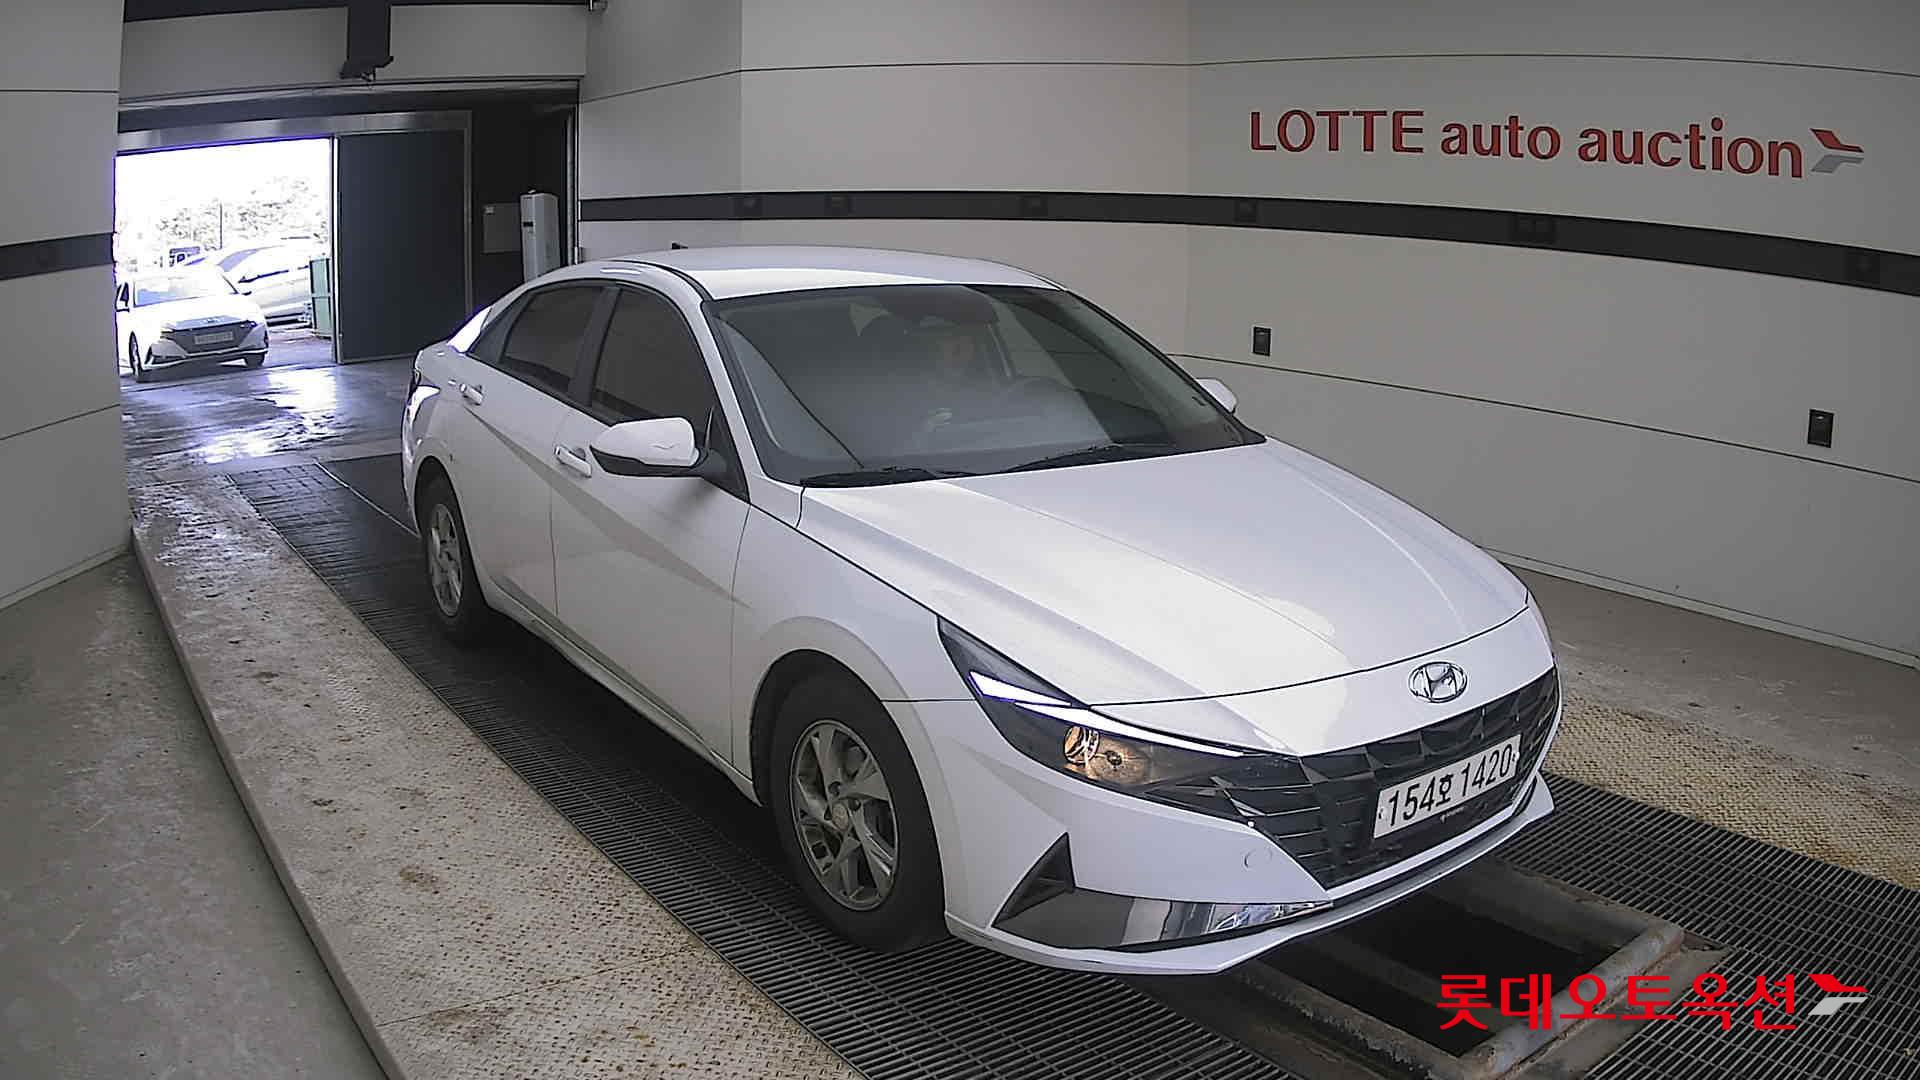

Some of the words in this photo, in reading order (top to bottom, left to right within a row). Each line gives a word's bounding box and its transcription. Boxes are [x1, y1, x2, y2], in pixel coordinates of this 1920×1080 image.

[1250, 111, 1424, 154] LOTTE
[1440, 115, 1561, 161] auto
[1577, 117, 1804, 179] auction
[1388, 773, 1454, 827] 154호
[1461, 744, 1513, 797] 1420
